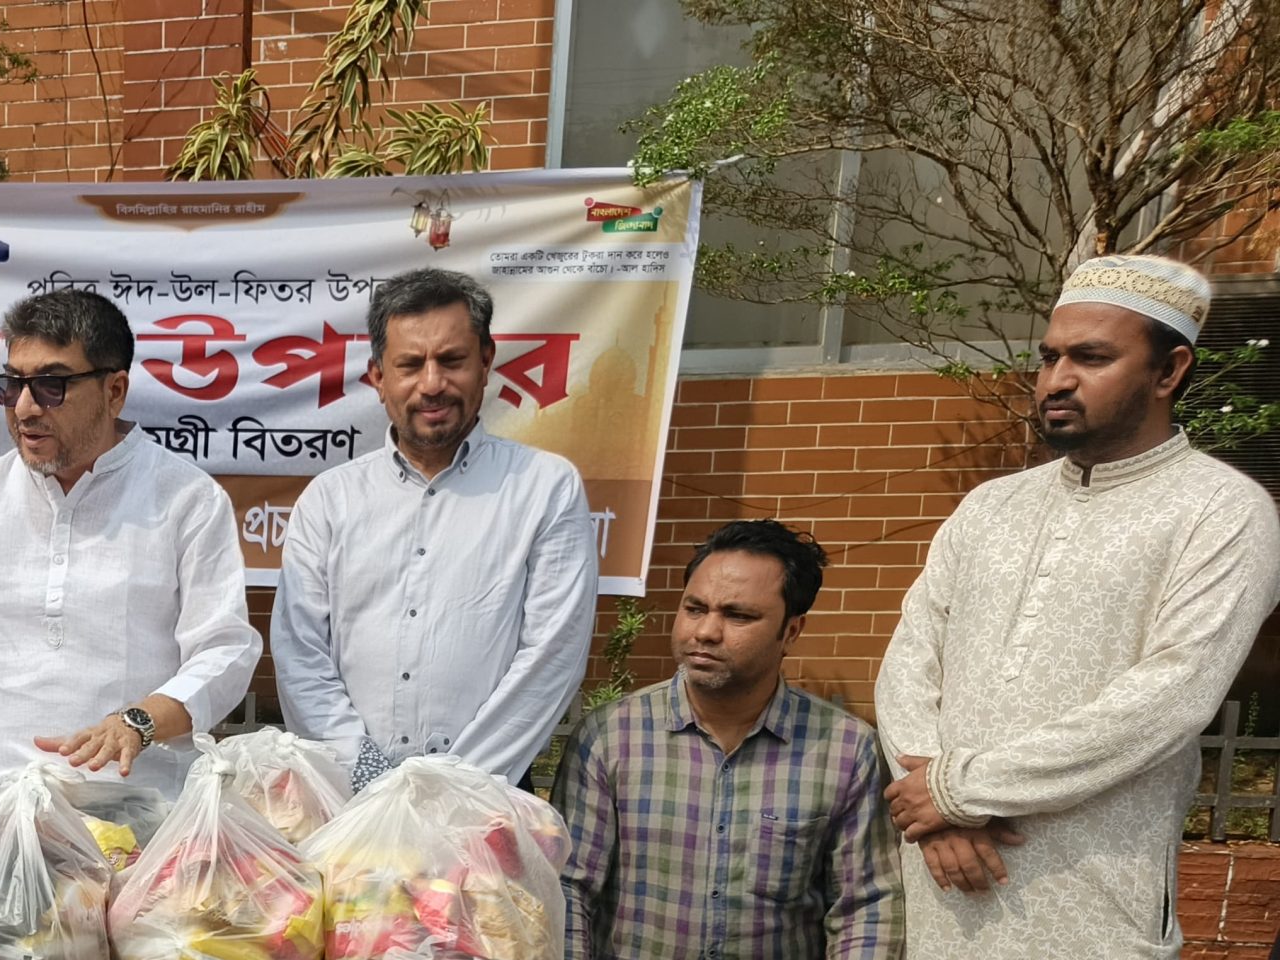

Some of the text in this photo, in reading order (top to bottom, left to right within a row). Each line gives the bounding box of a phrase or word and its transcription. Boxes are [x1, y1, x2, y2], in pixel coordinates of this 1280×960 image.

[181, 202, 230, 215] রাহমানির
[234, 201, 266, 214] রাহীম
[591, 207, 632, 217] বাংলাদেশ
[490, 249, 670, 263] তোমরা একটি খেজুরের টুকরা দান করে হলেও
[492, 265, 533, 276] জাহান্নামের
[536, 265, 559, 275] আগুন
[562, 264, 584, 274] থেকে
[642, 263, 666, 274] হাদিস
[226, 415, 362, 461] বিতরণ
